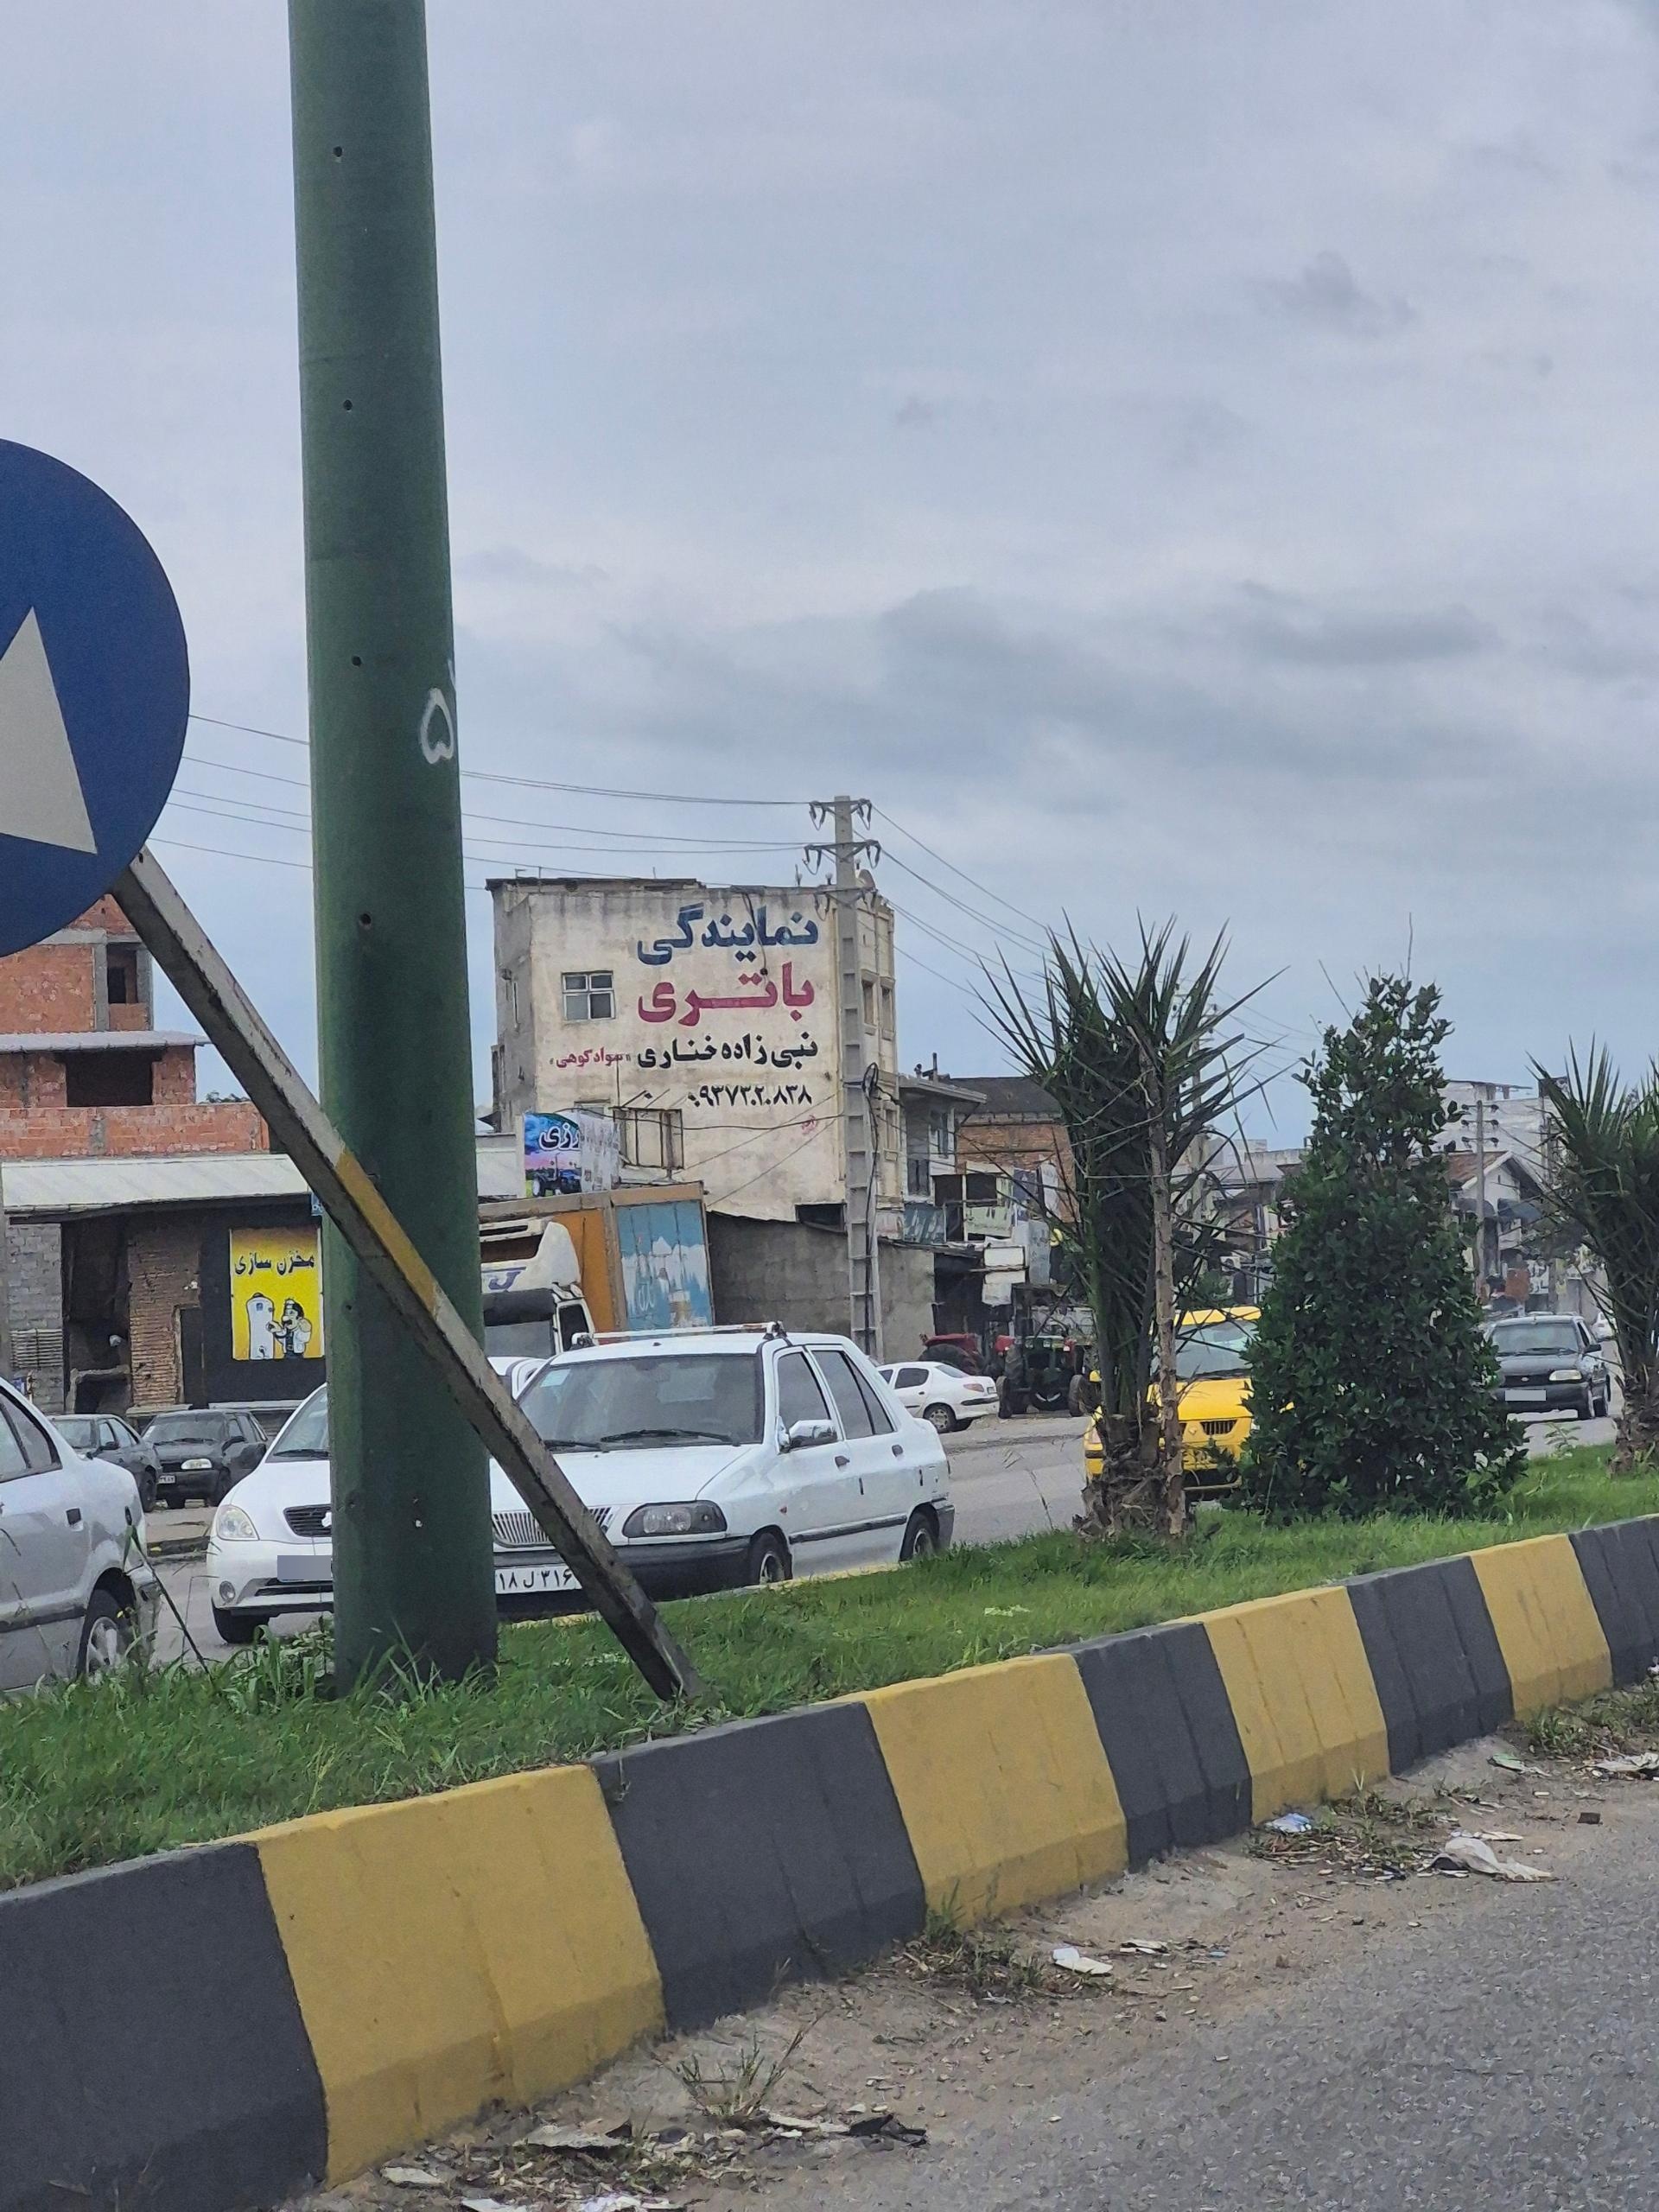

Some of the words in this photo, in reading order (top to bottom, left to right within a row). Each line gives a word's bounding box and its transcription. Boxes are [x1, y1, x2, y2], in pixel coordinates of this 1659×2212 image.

[638, 902, 818, 966] نمایندگی
[638, 961, 815, 1027] باتری
[638, 1035, 717, 1069] خناری
[721, 1033, 767, 1065] زاده
[771, 1032, 818, 1070] نبی
[234, 1252, 272, 1275] سازی
[277, 1250, 315, 1275] مخزن
